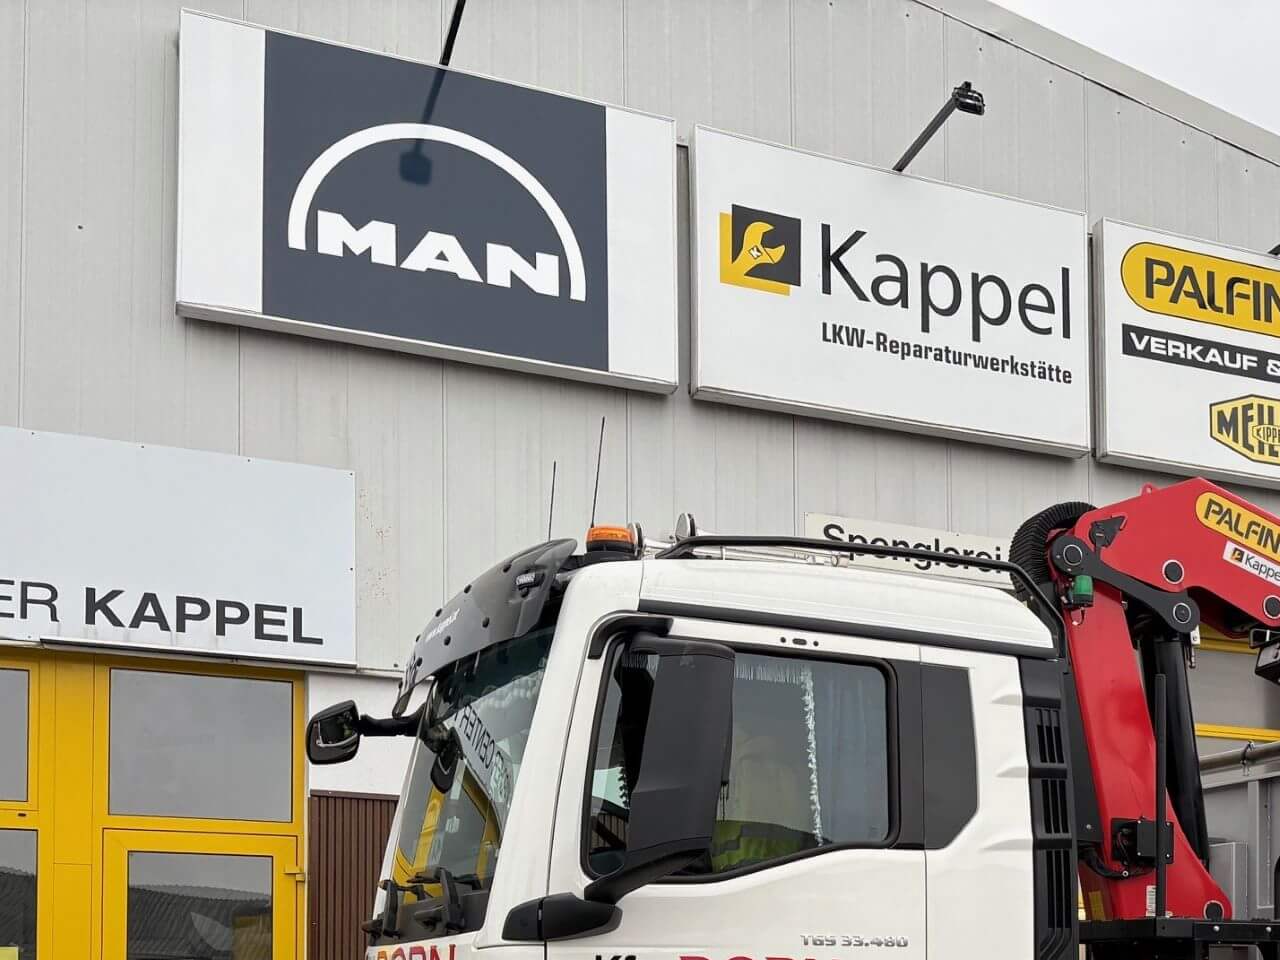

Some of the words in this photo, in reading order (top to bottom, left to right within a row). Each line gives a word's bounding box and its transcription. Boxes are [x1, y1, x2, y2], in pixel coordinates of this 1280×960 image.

[317, 209, 560, 297] MAN
[821, 223, 1071, 343] Kappel
[821, 321, 1073, 385] LKW-Reparaturwerkstätte
[1129, 331, 1258, 371] VERKAUF
[85, 586, 324, 645] KAPPEL
[841, 936, 909, 948] 33.480
